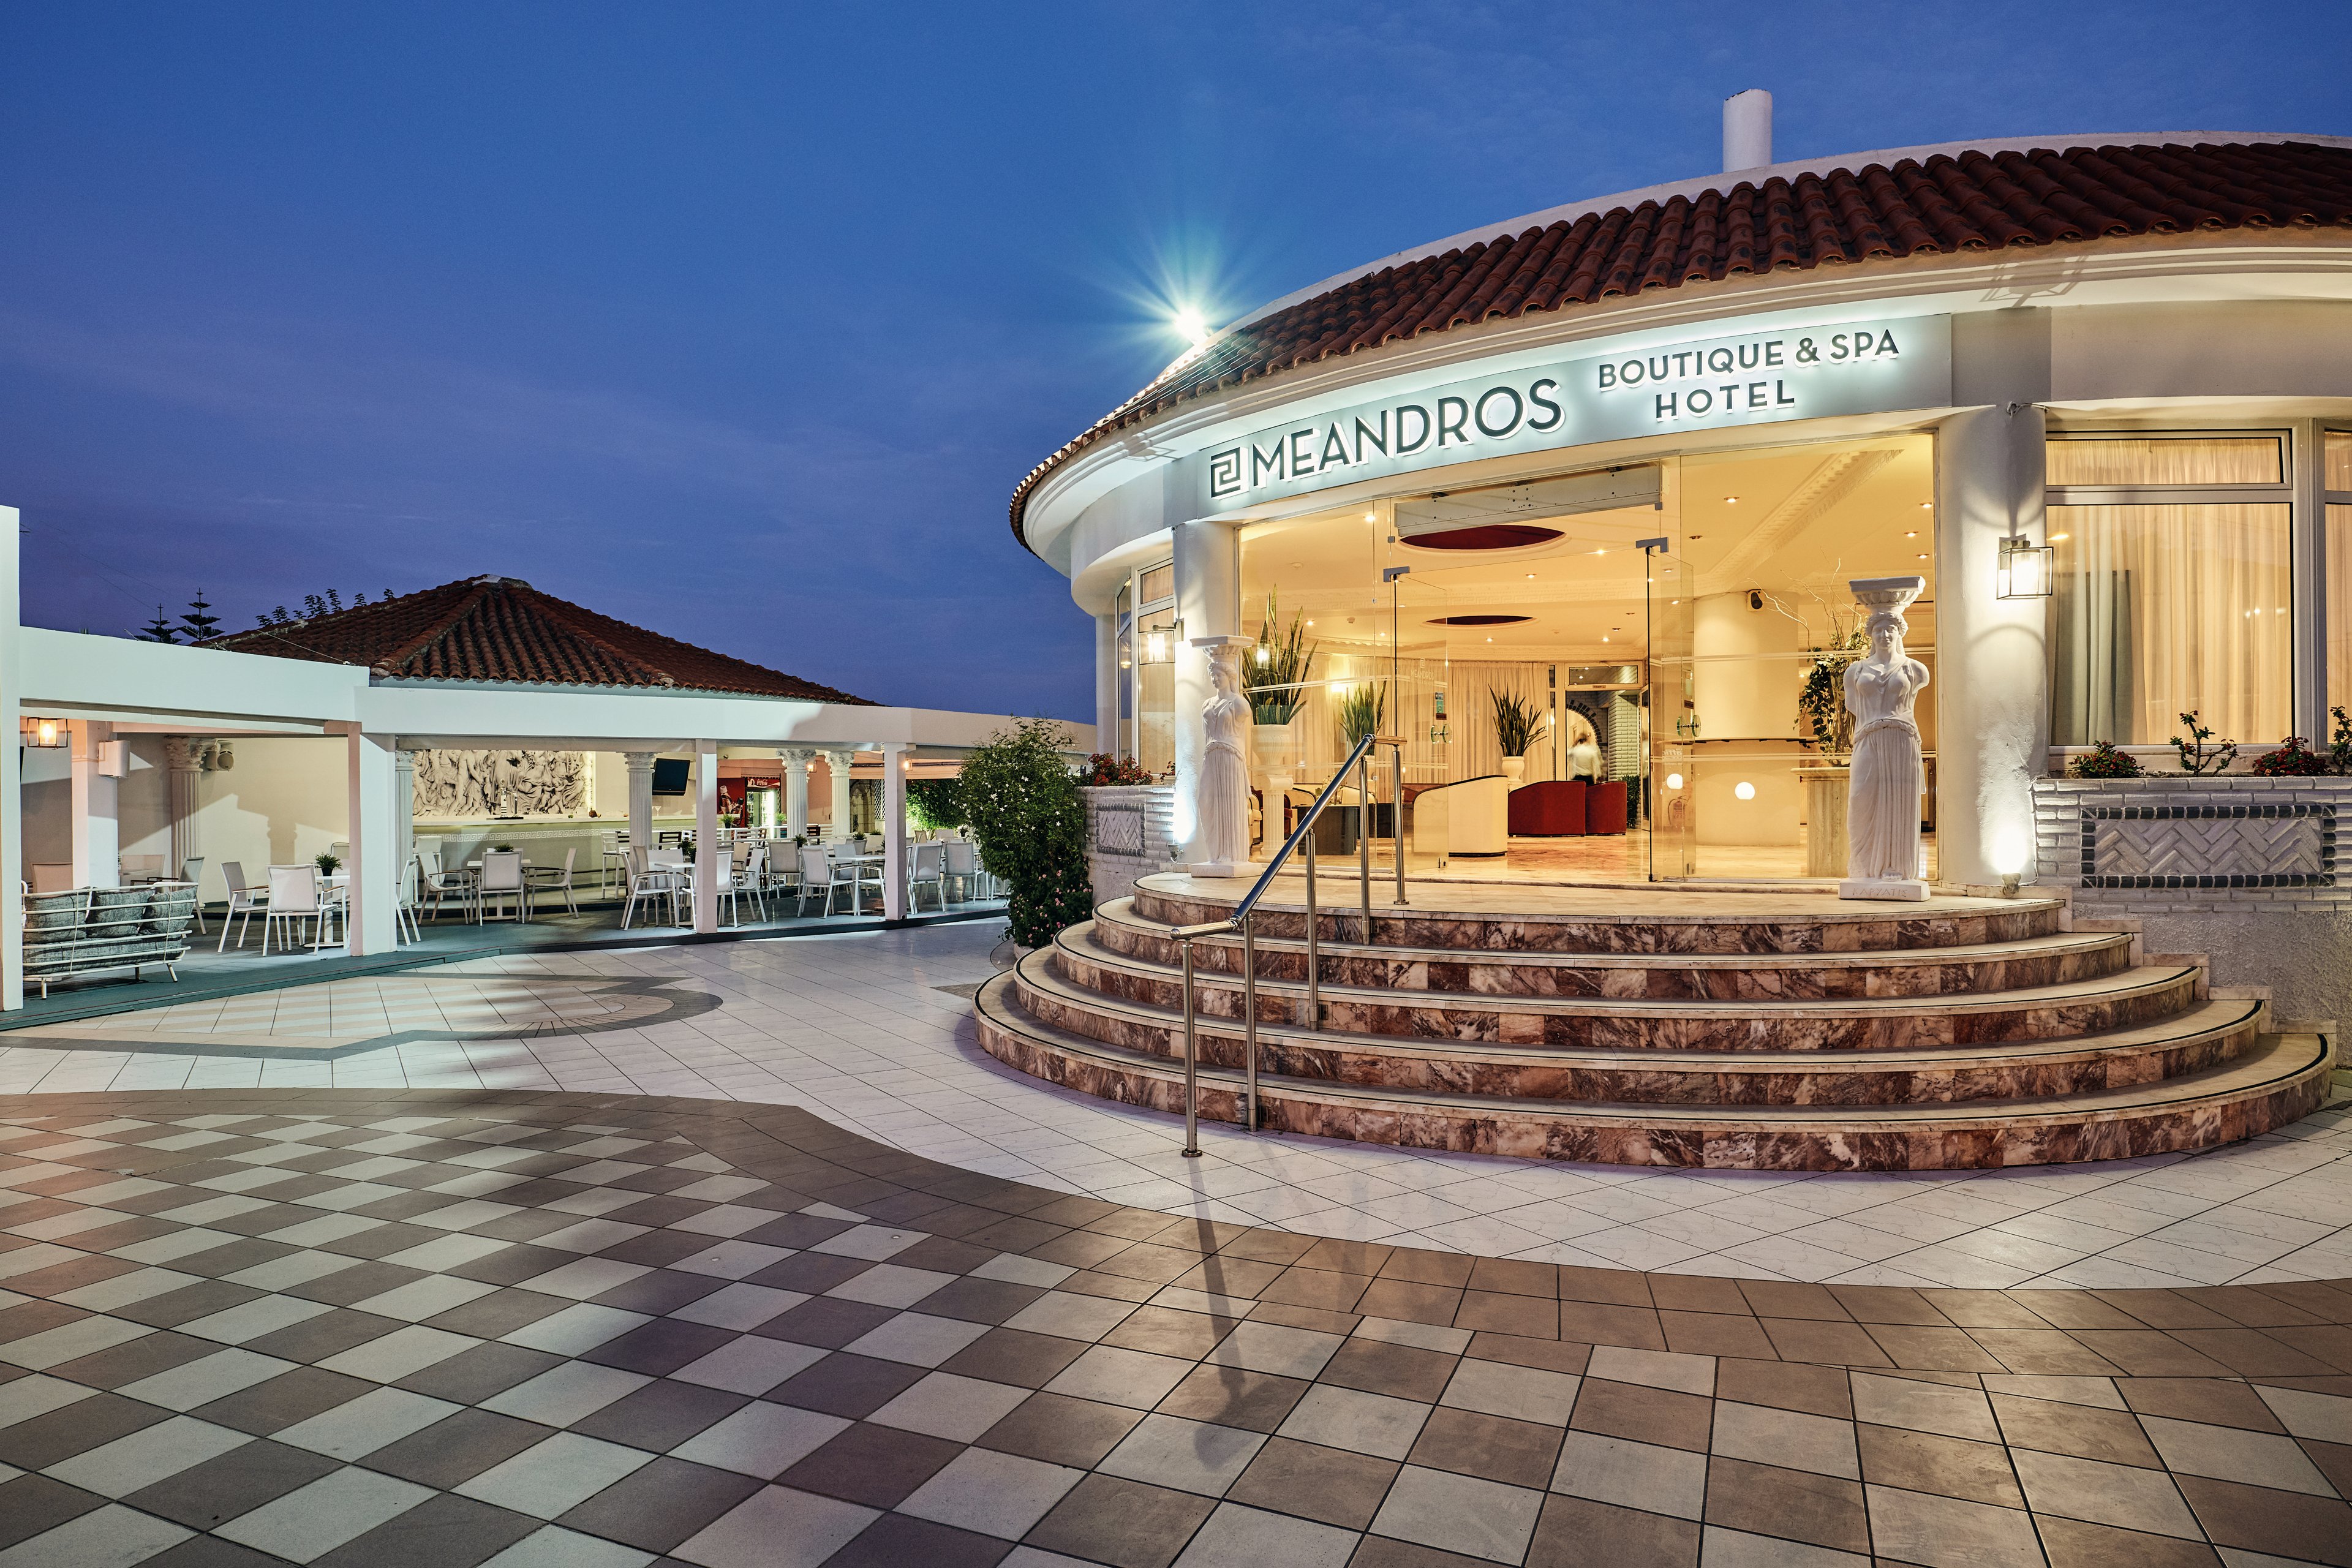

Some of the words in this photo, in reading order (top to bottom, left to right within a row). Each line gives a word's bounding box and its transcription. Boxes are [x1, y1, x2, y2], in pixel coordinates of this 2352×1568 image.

[1599, 341, 1784, 388] BOUTIQUE
[1796, 337, 1821, 363] &
[1830, 329, 1899, 360] SPA
[1656, 379, 1795, 418] HOTEL
[1253, 379, 1563, 488] MEANDROS
